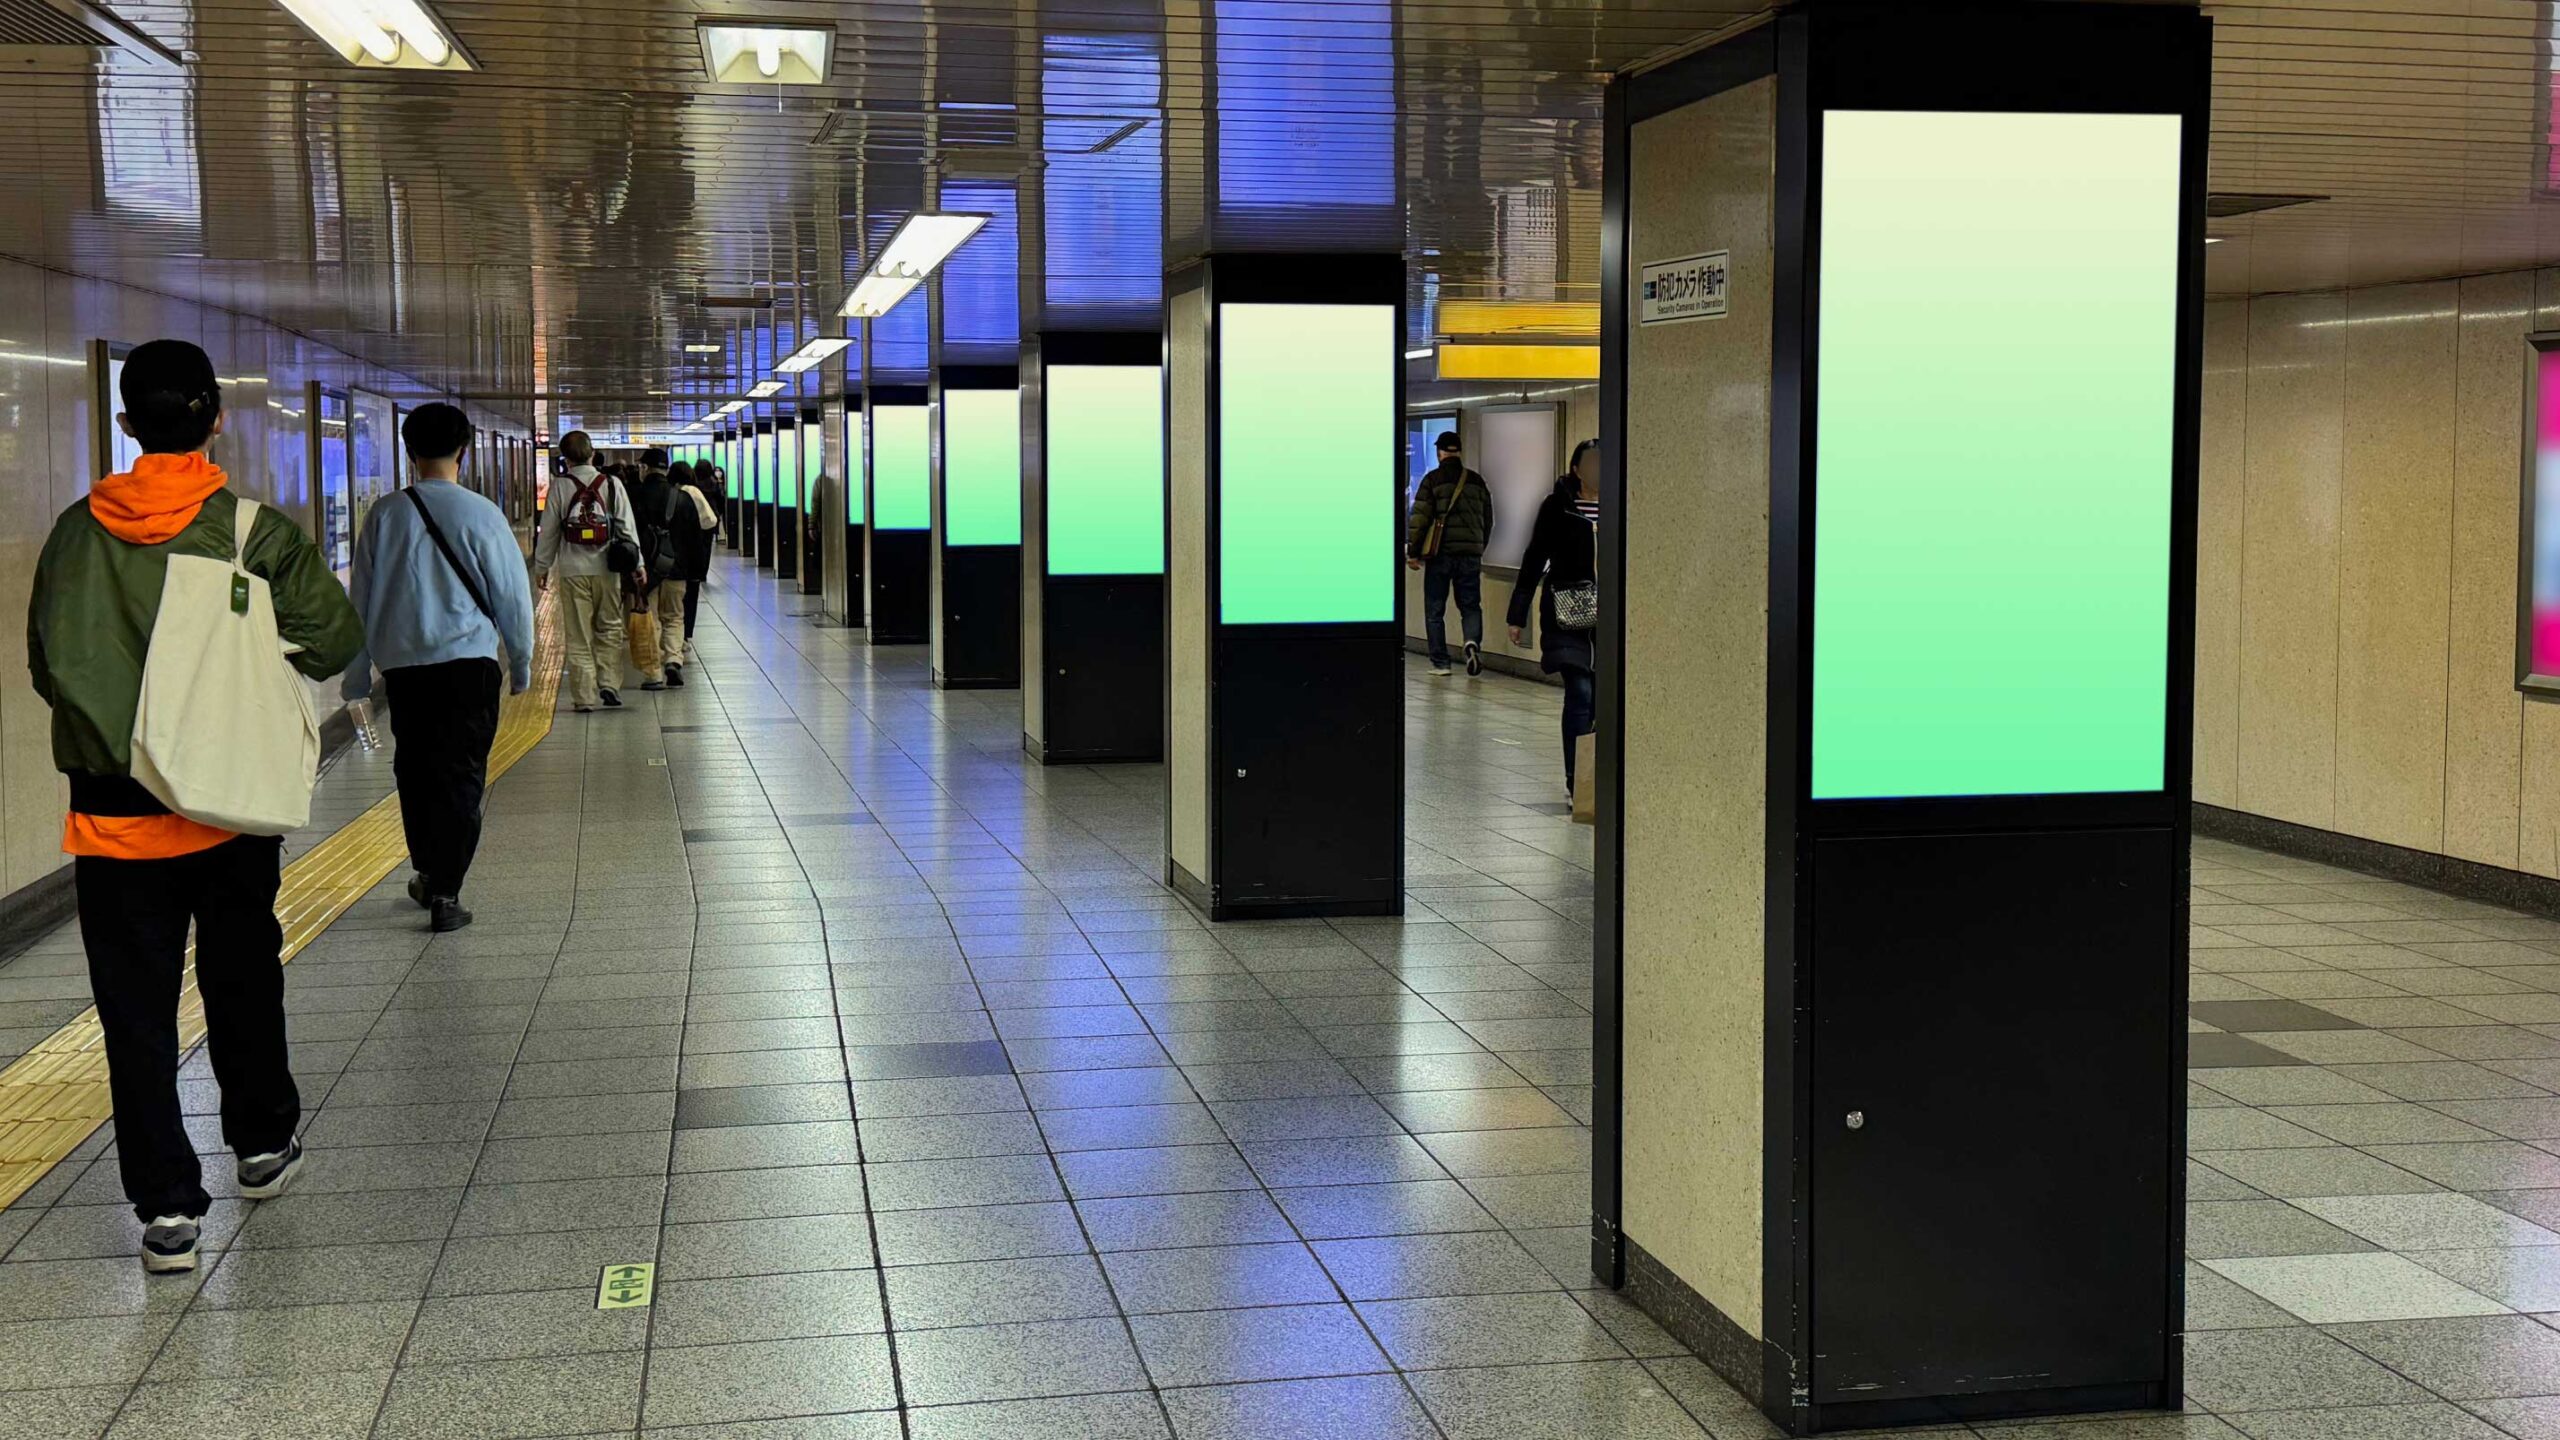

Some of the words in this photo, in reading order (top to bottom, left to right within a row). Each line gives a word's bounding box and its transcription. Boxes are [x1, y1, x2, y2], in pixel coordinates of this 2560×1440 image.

[1658, 264, 1724, 303] 防犯カメラ作動中
[1657, 305, 1675, 315] Security
[1676, 303, 1695, 312] Cameras
[1701, 300, 1724, 310] Operation
